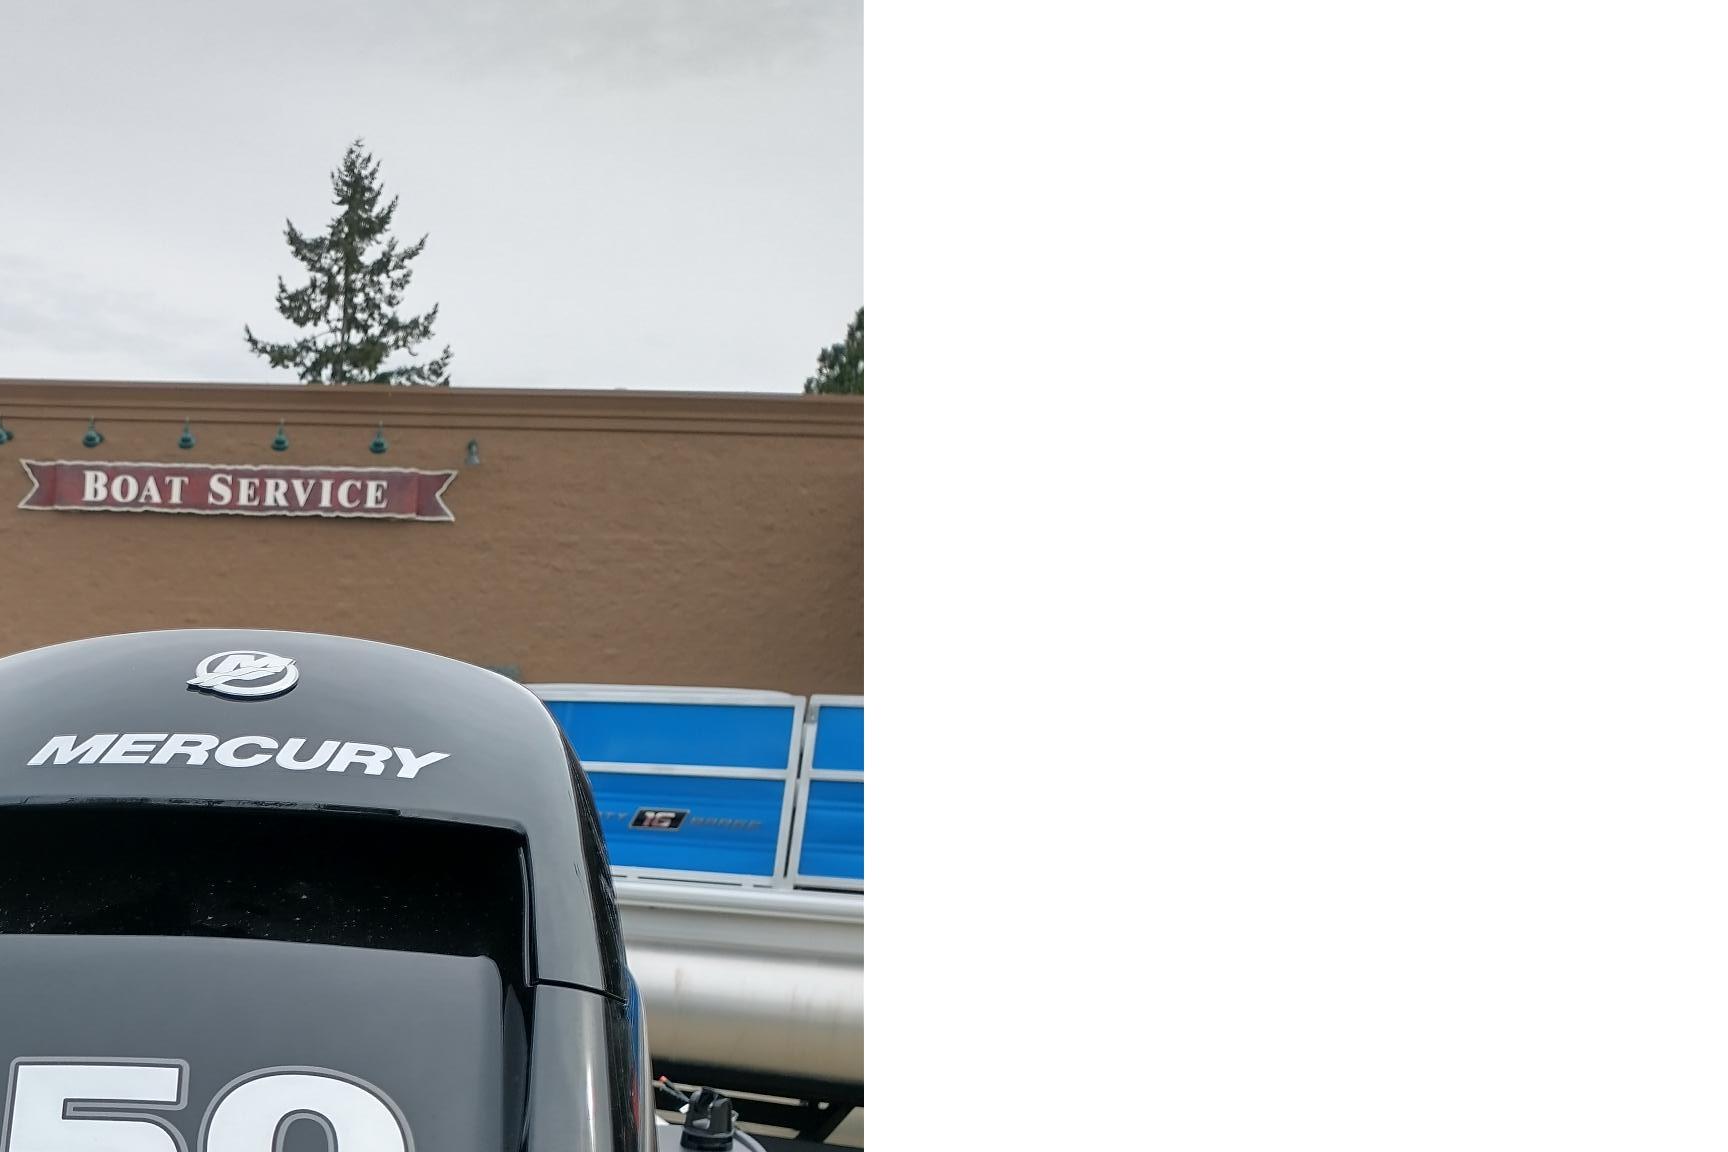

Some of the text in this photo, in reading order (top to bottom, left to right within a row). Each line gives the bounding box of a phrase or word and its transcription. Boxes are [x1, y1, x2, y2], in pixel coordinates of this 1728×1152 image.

[82, 469, 389, 510] BOAT SERVICE
[26, 733, 453, 780] MERCURY
